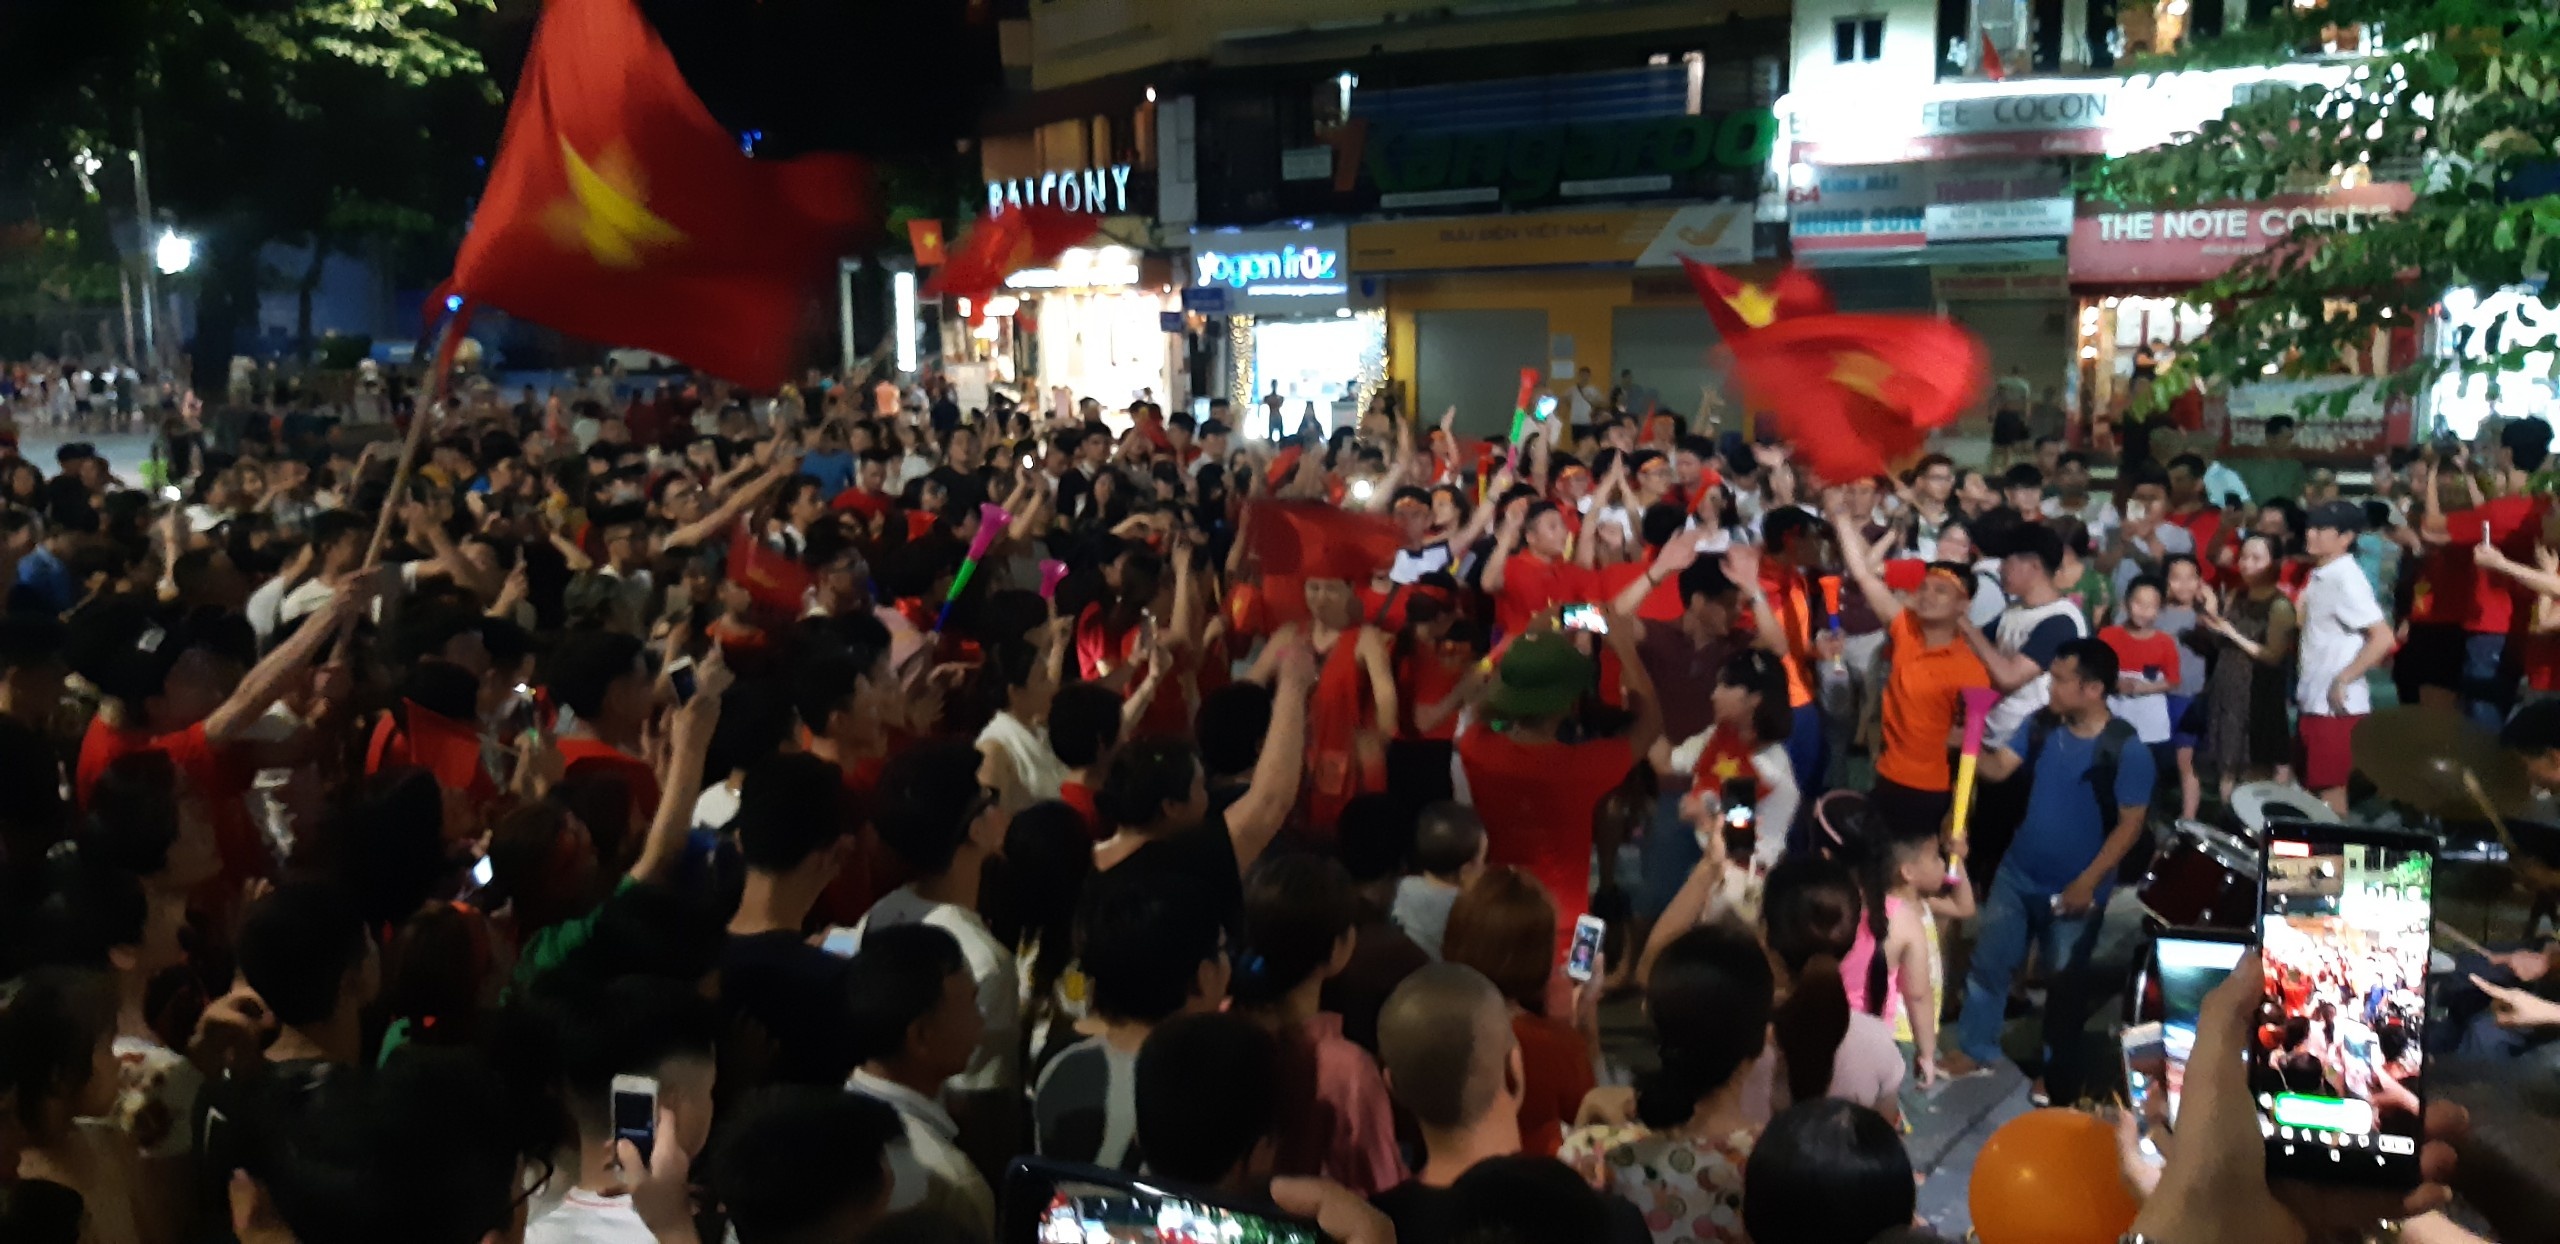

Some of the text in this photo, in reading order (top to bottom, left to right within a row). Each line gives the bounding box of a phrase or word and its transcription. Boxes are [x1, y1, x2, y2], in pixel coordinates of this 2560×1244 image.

[1328, 107, 1777, 200] Kangaroo
[2098, 211, 2154, 240] THE
[2162, 208, 2248, 238] NOTE
